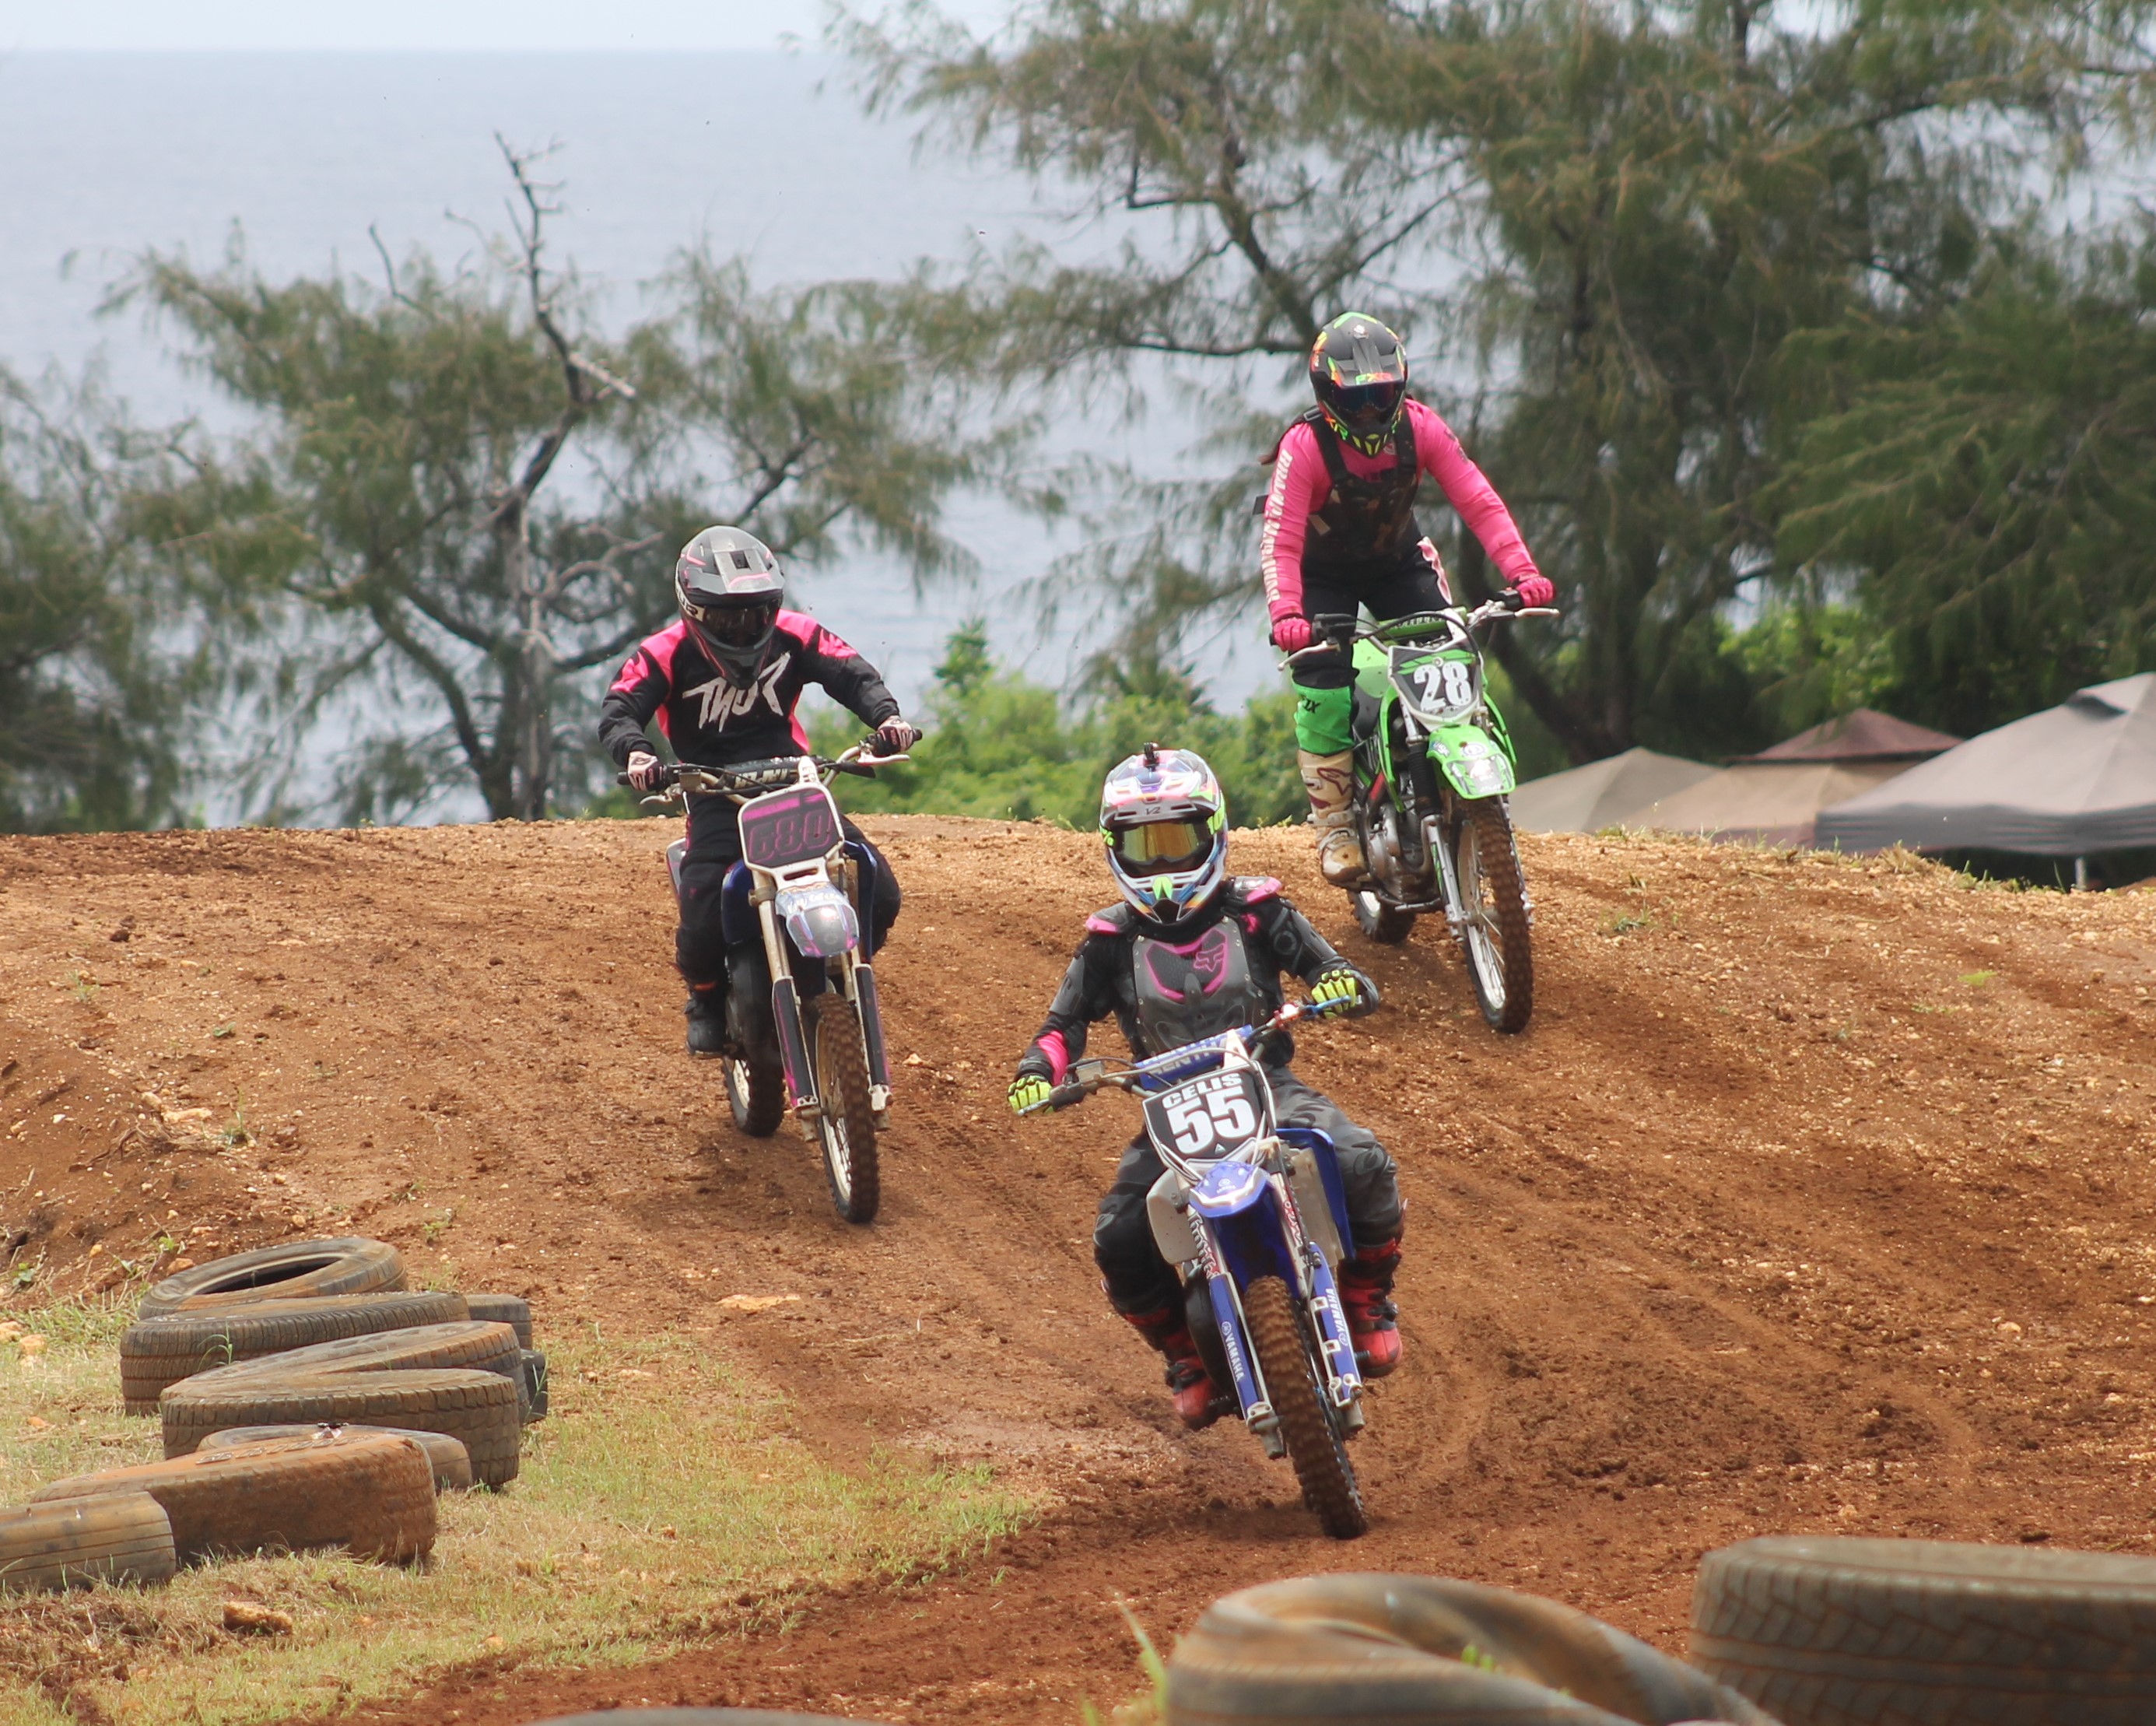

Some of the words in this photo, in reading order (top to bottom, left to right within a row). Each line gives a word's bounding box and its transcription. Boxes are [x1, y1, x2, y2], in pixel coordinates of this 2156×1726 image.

[682, 651, 791, 733] THOR
[1413, 661, 1473, 712] 28
[748, 810, 832, 863] 680
[1162, 1072, 1243, 1109] CELIS
[1167, 1086, 1256, 1154] 55
[1325, 1288, 1348, 1334] YAMAHA
[1225, 1332, 1245, 1383] YAMAHA
